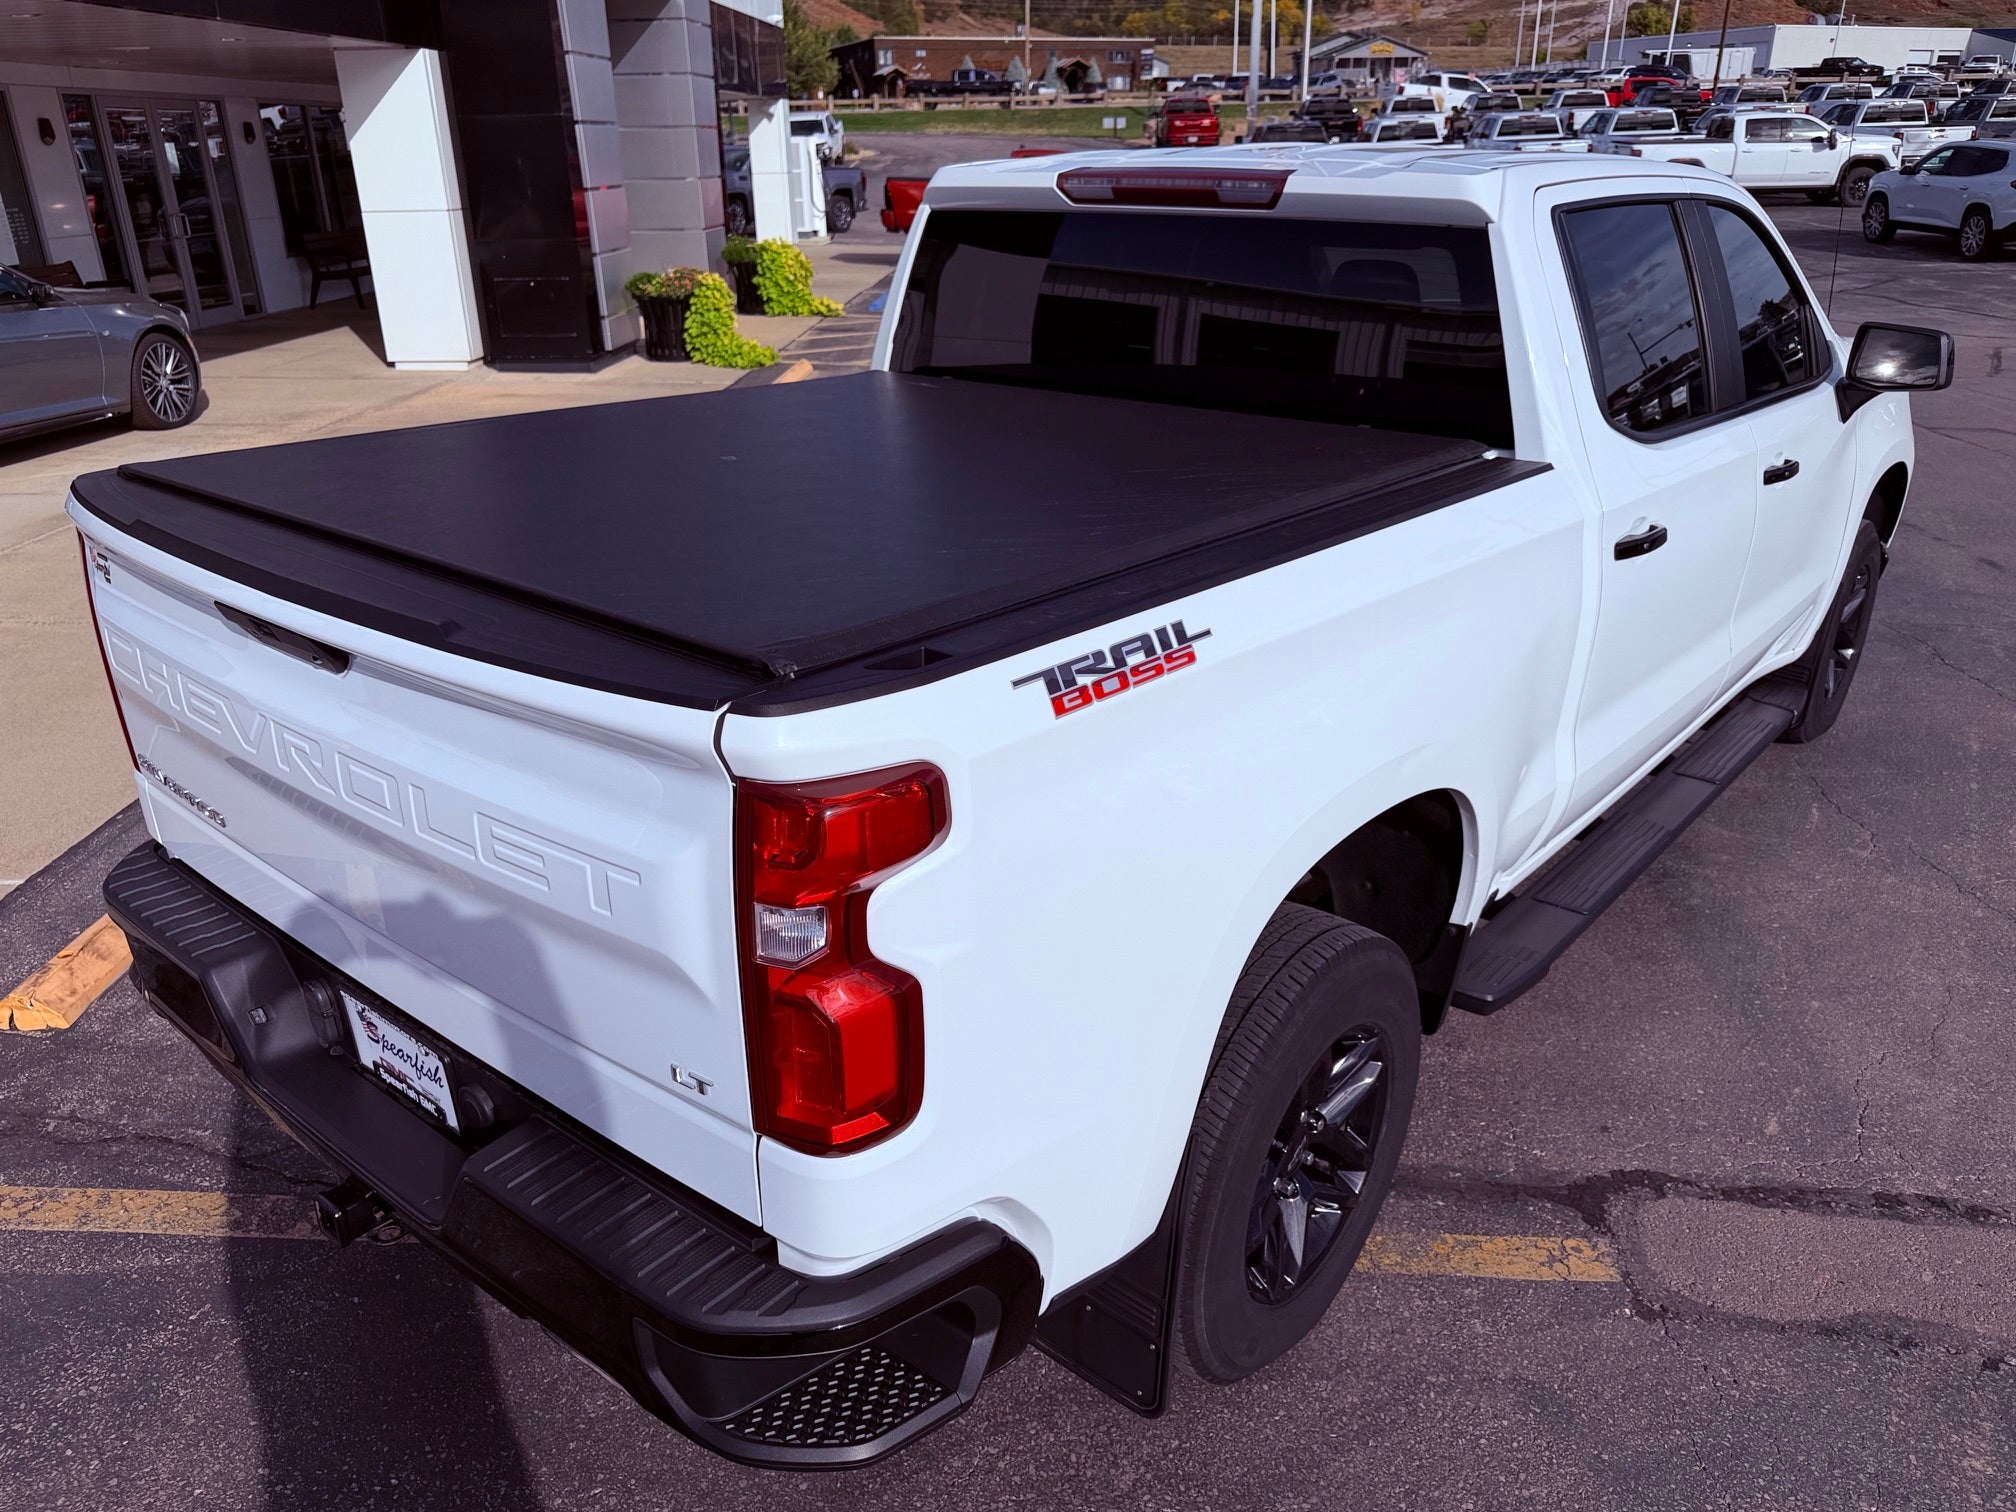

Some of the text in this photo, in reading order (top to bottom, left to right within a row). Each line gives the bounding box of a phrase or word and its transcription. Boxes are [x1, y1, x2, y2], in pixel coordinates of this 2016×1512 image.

[1010, 619, 1213, 696] TRAIL
[1050, 643, 1197, 720] BOSS
[104, 625, 642, 918] CHEVROLET
[366, 1020, 444, 1088] Spearfish
[670, 1062, 715, 1096] LT
